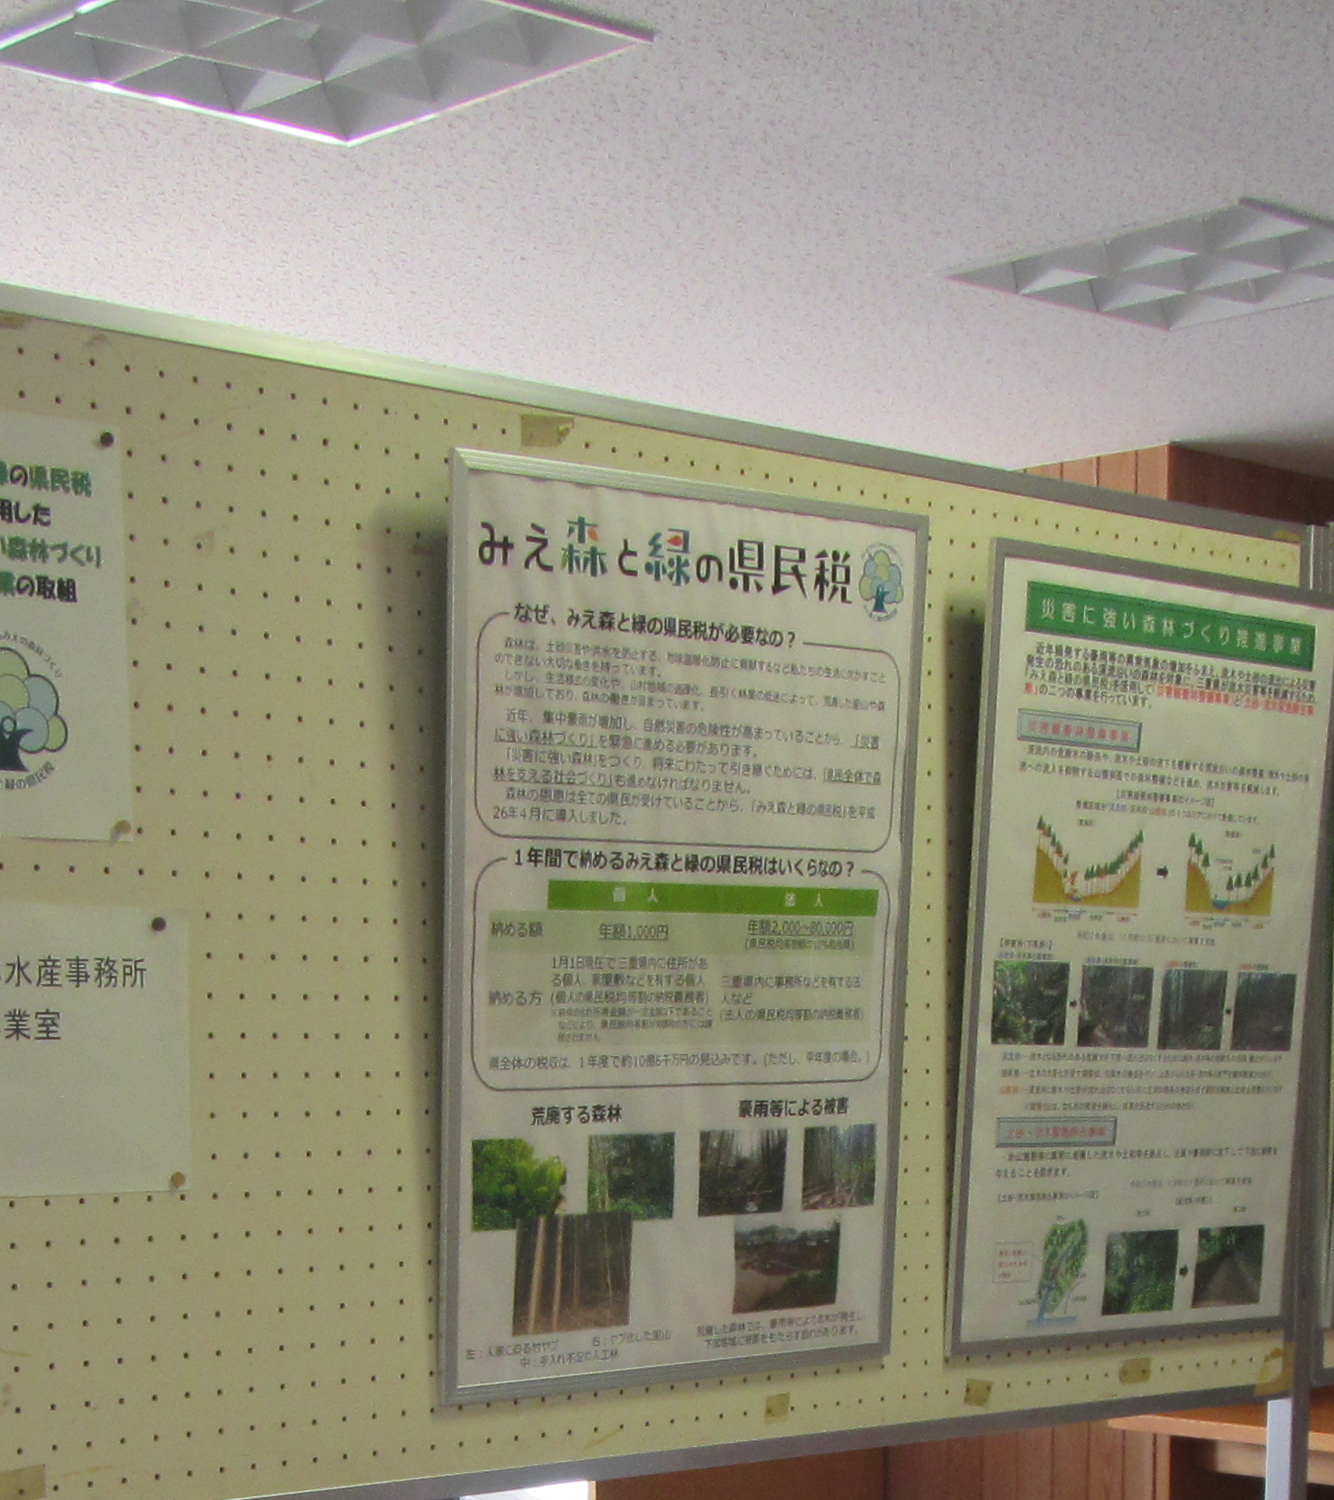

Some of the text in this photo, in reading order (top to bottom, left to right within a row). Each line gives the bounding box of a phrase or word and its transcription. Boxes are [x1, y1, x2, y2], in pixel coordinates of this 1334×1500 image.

[477, 515, 853, 605] みえ森と緑の県民税
[489, 990, 543, 1006] 納める方
[530, 1104, 623, 1126] 荒廃する森林
[738, 1097, 849, 1118] 豪雨等による被害
